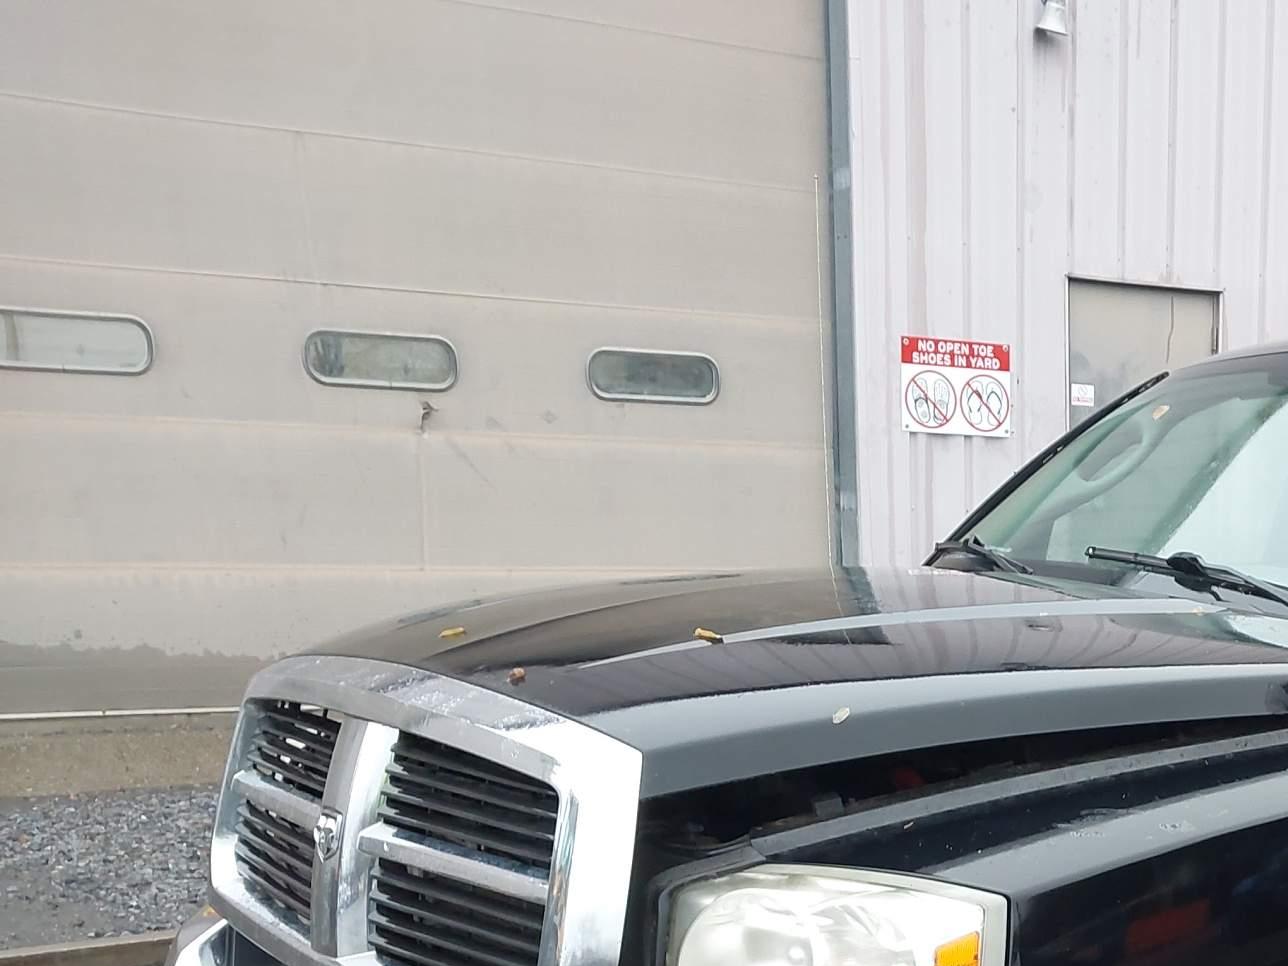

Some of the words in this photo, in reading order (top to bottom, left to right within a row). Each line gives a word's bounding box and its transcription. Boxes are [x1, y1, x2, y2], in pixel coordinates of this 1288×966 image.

[917, 339, 935, 352] NO
[937, 342, 970, 355] OPEN
[972, 344, 994, 357] TOE
[912, 352, 951, 365] SHOES
[954, 355, 967, 367] IN
[969, 356, 1000, 369] YARD
